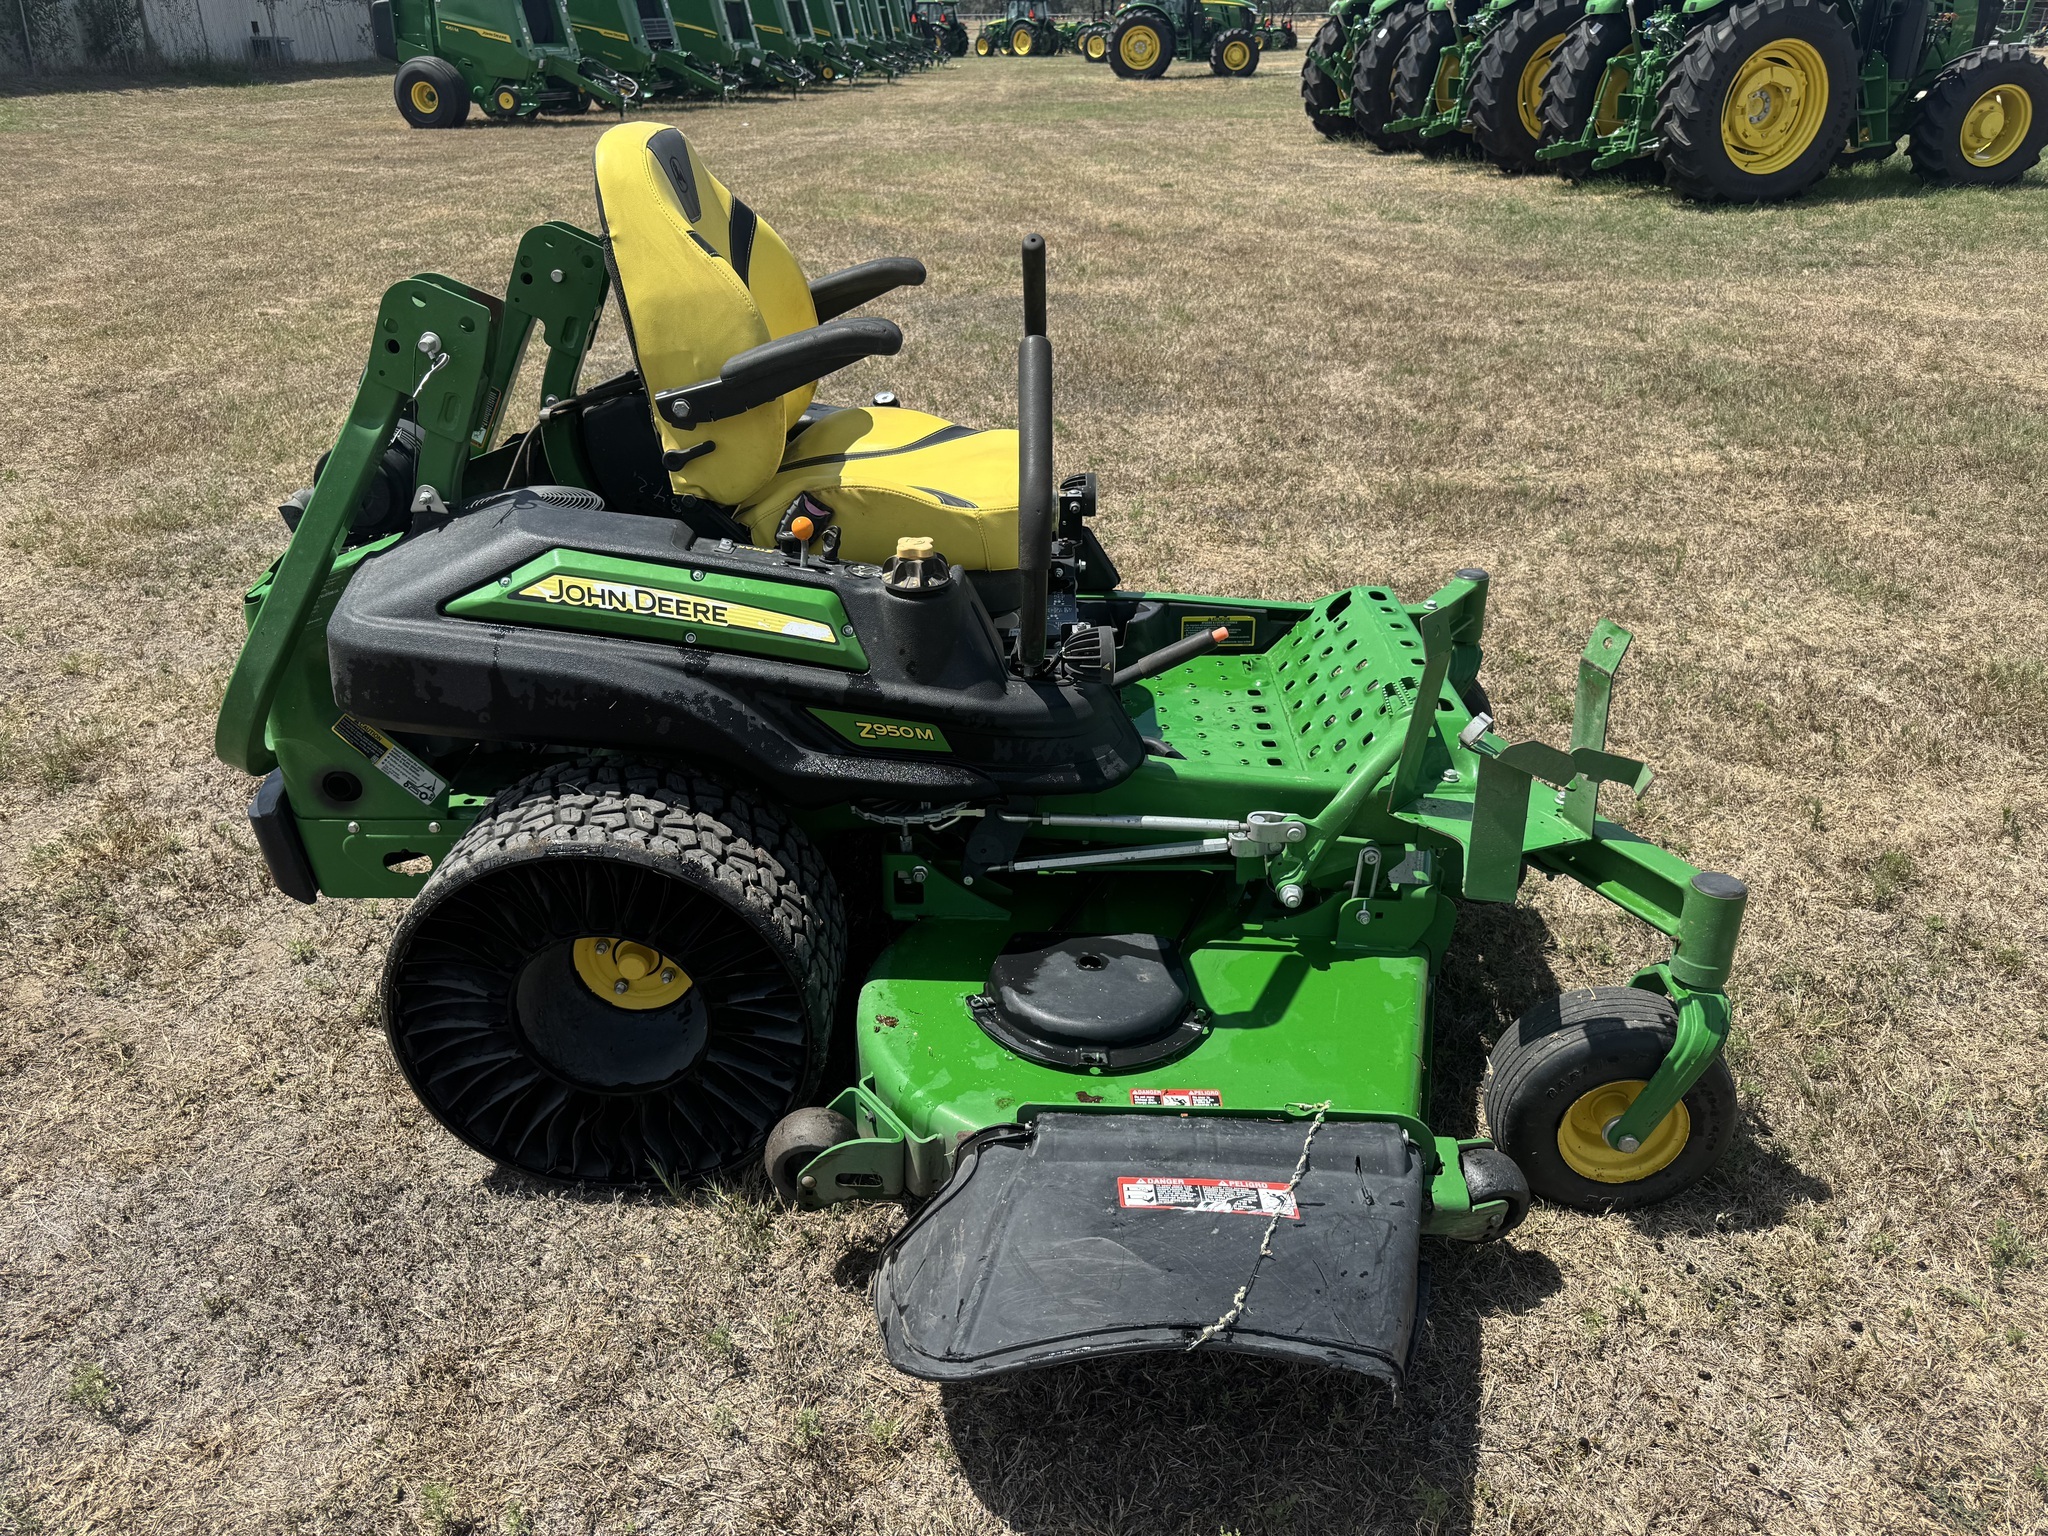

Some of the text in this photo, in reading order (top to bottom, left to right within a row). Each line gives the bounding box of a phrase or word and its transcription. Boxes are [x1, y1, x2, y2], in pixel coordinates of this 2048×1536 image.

[549, 579, 728, 624] JOHN DEERE
[359, 721, 383, 742] CAUTION
[1228, 1180, 1268, 1189] PELIGRO
